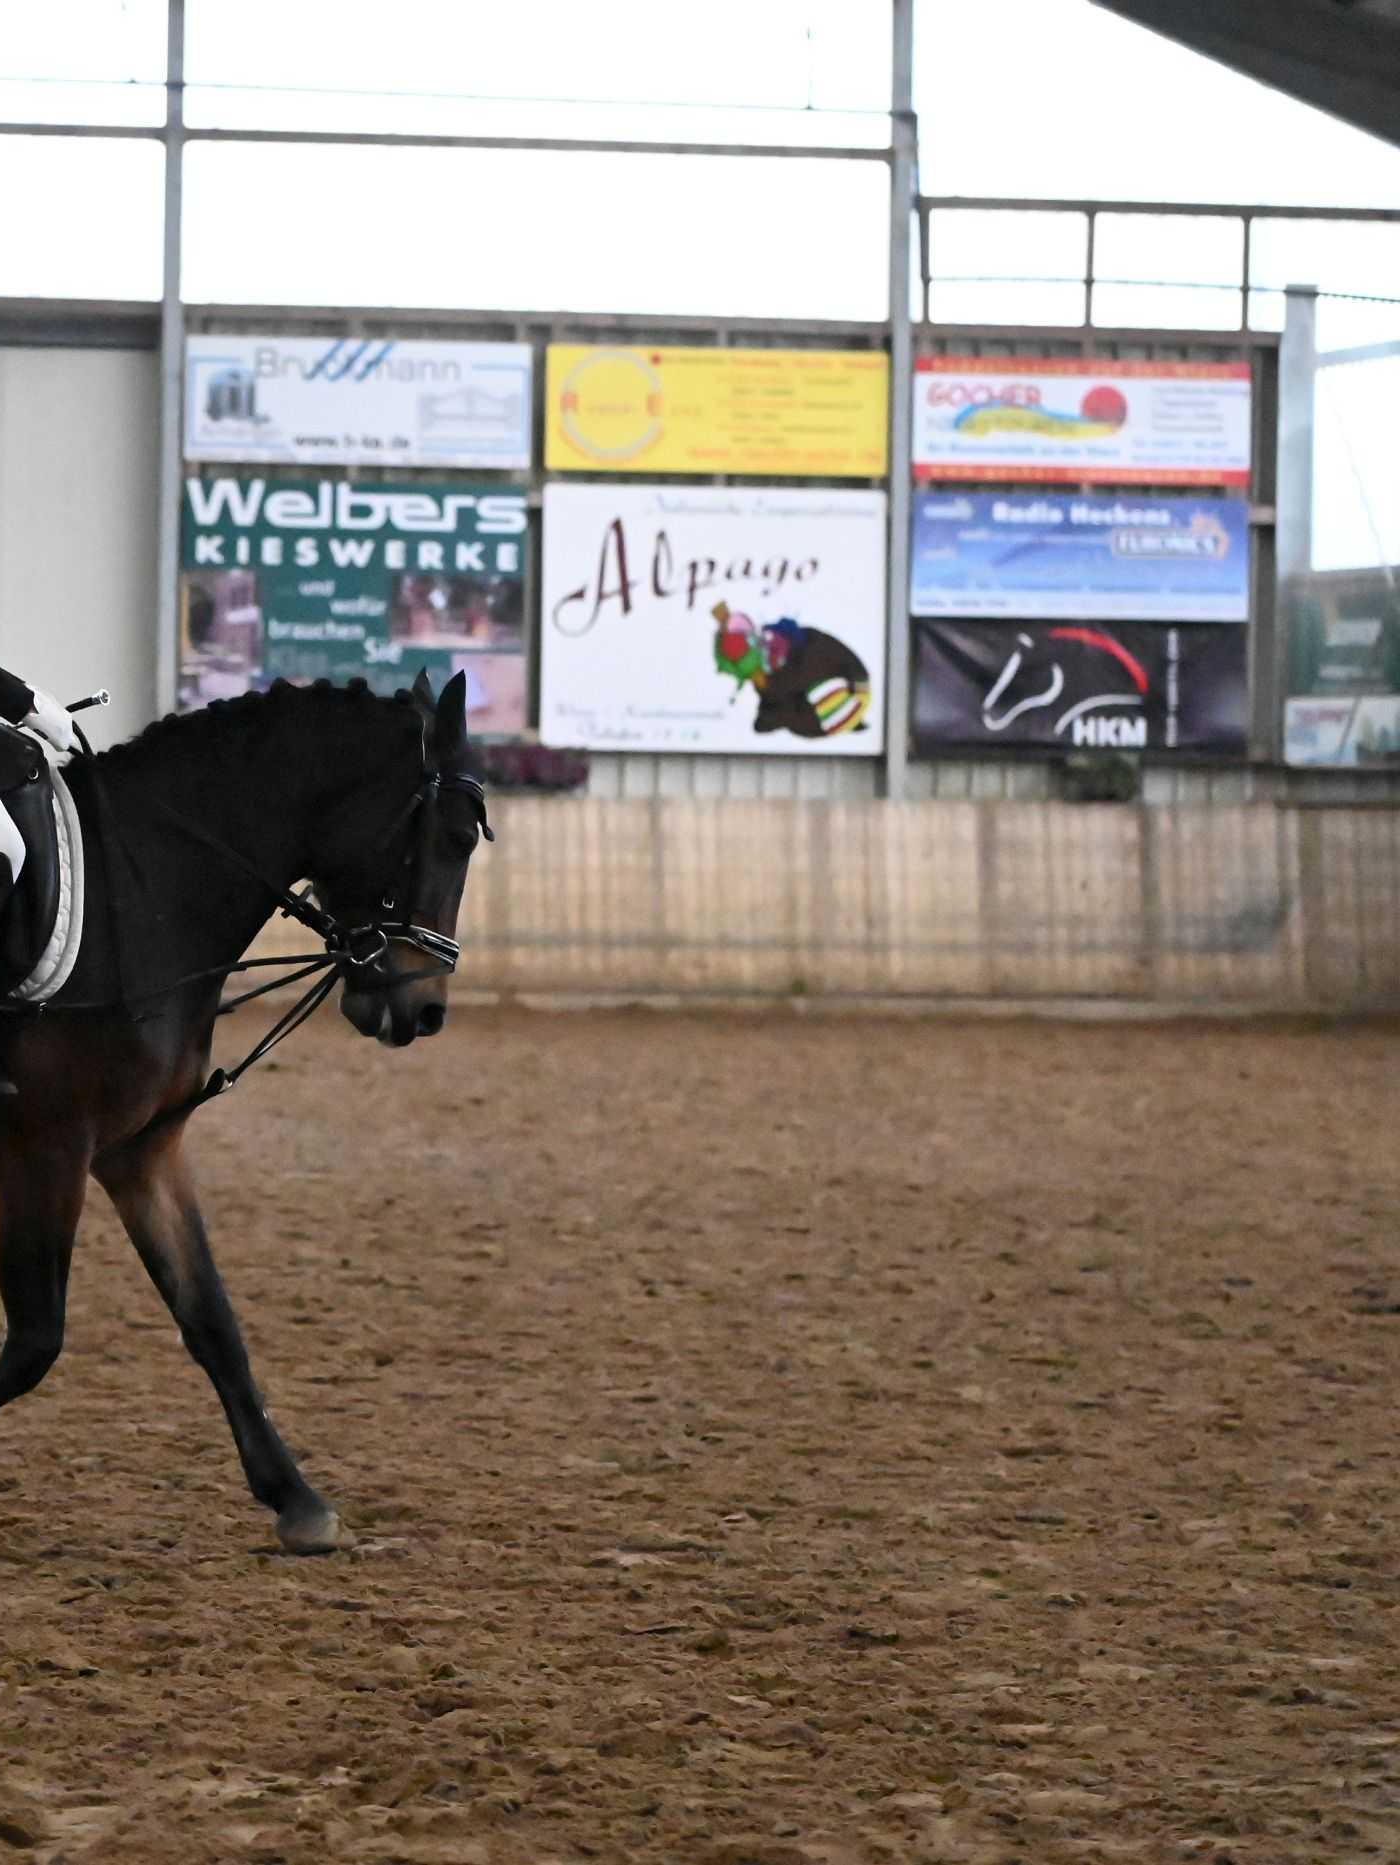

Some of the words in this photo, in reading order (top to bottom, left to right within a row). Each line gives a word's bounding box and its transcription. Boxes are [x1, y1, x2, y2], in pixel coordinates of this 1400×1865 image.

[186, 477, 528, 534] Welbers
[194, 535, 520, 572] KIESWERKE
[1072, 715, 1148, 748] HKM
